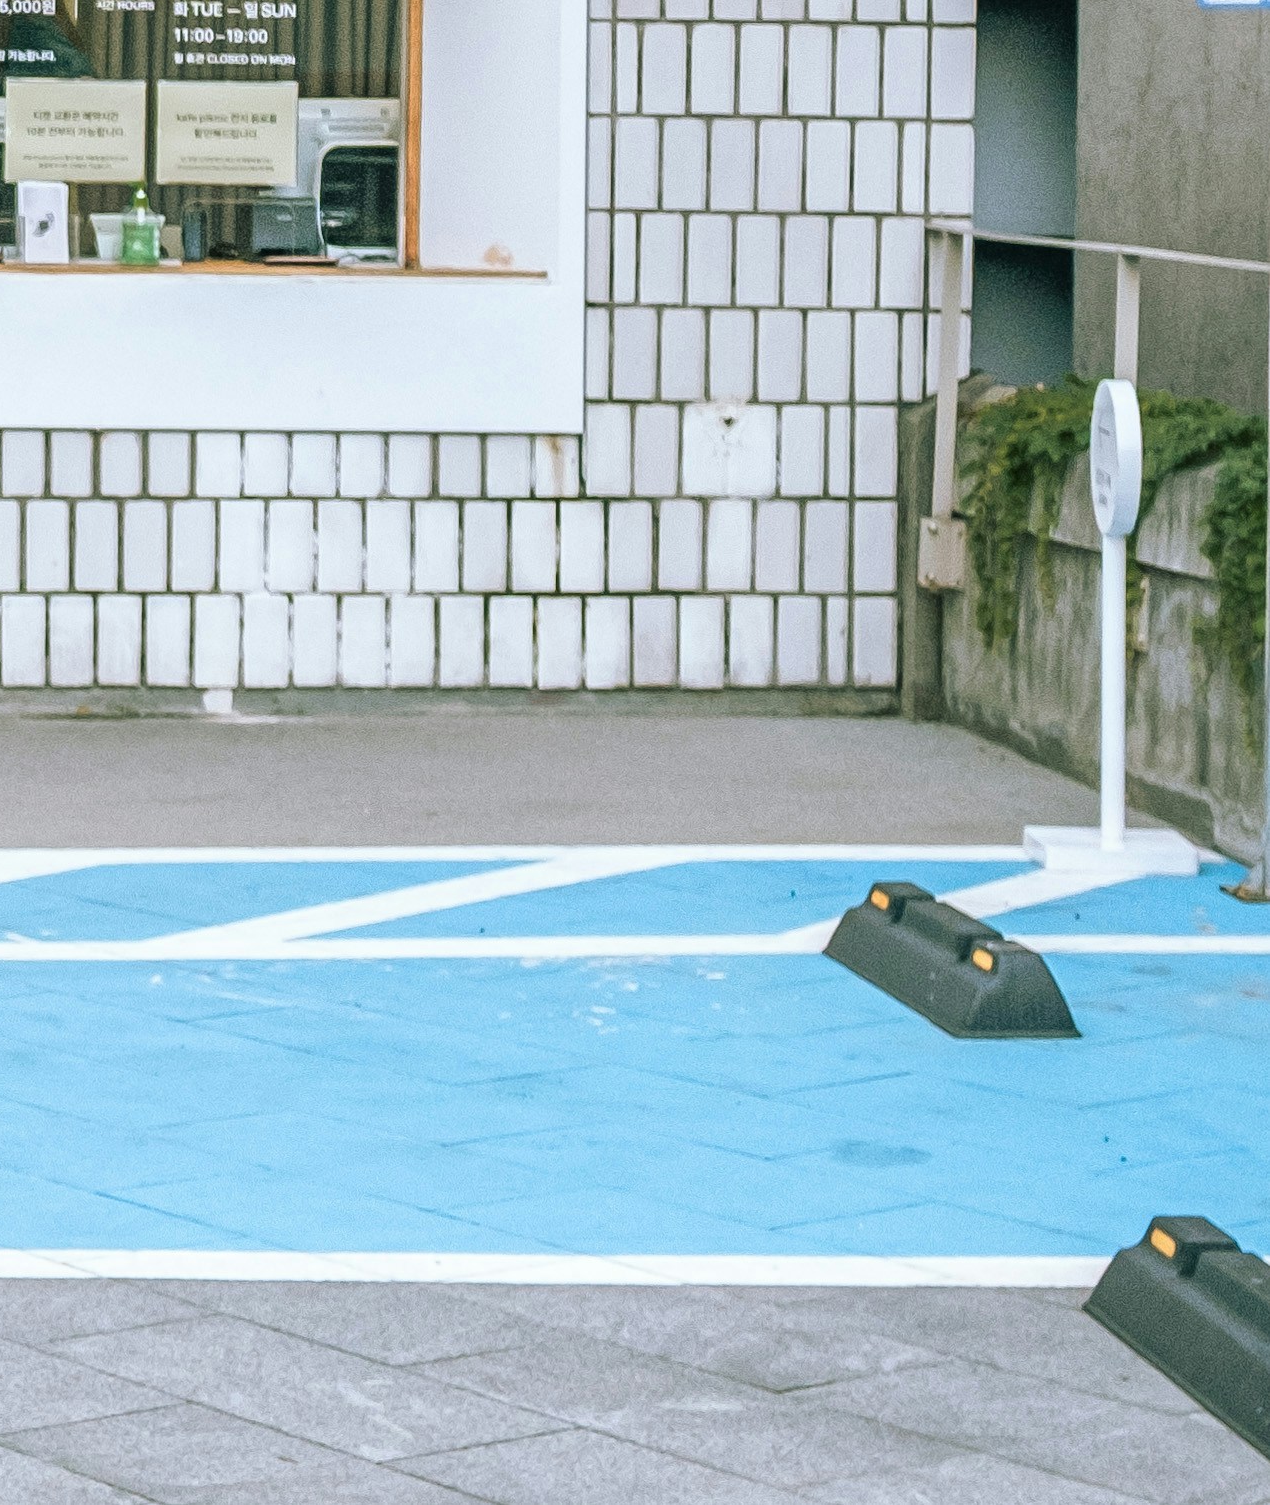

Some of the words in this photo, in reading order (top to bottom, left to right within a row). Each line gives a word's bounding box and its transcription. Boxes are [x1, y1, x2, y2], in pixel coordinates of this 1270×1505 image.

[116, 0, 155, 11] HOURS
[190, 1, 224, 18] TUE
[260, 2, 297, 18] SUN
[207, 53, 249, 65] CLOSED
[250, 53, 267, 65] ON
[269, 54, 296, 66] MON
